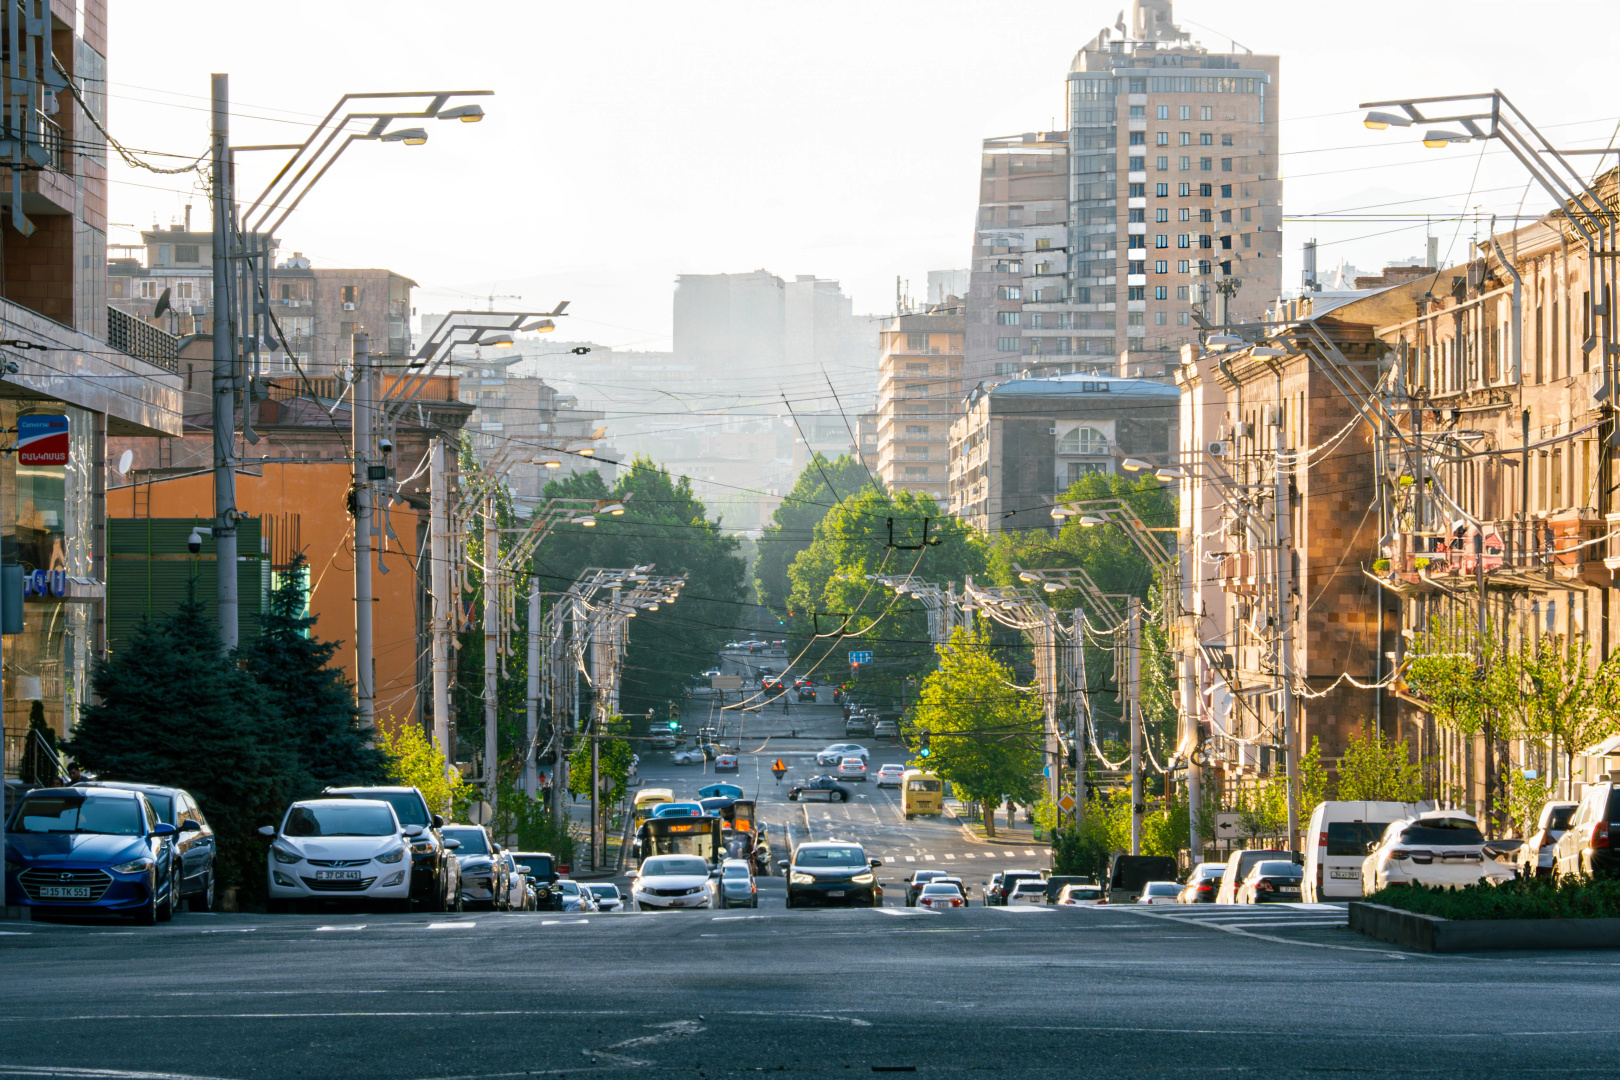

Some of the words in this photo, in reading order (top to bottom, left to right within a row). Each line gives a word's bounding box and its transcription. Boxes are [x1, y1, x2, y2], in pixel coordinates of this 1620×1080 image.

[50, 888, 59, 896] 15
[61, 888, 72, 896] TK
[74, 888, 87, 896] 551
